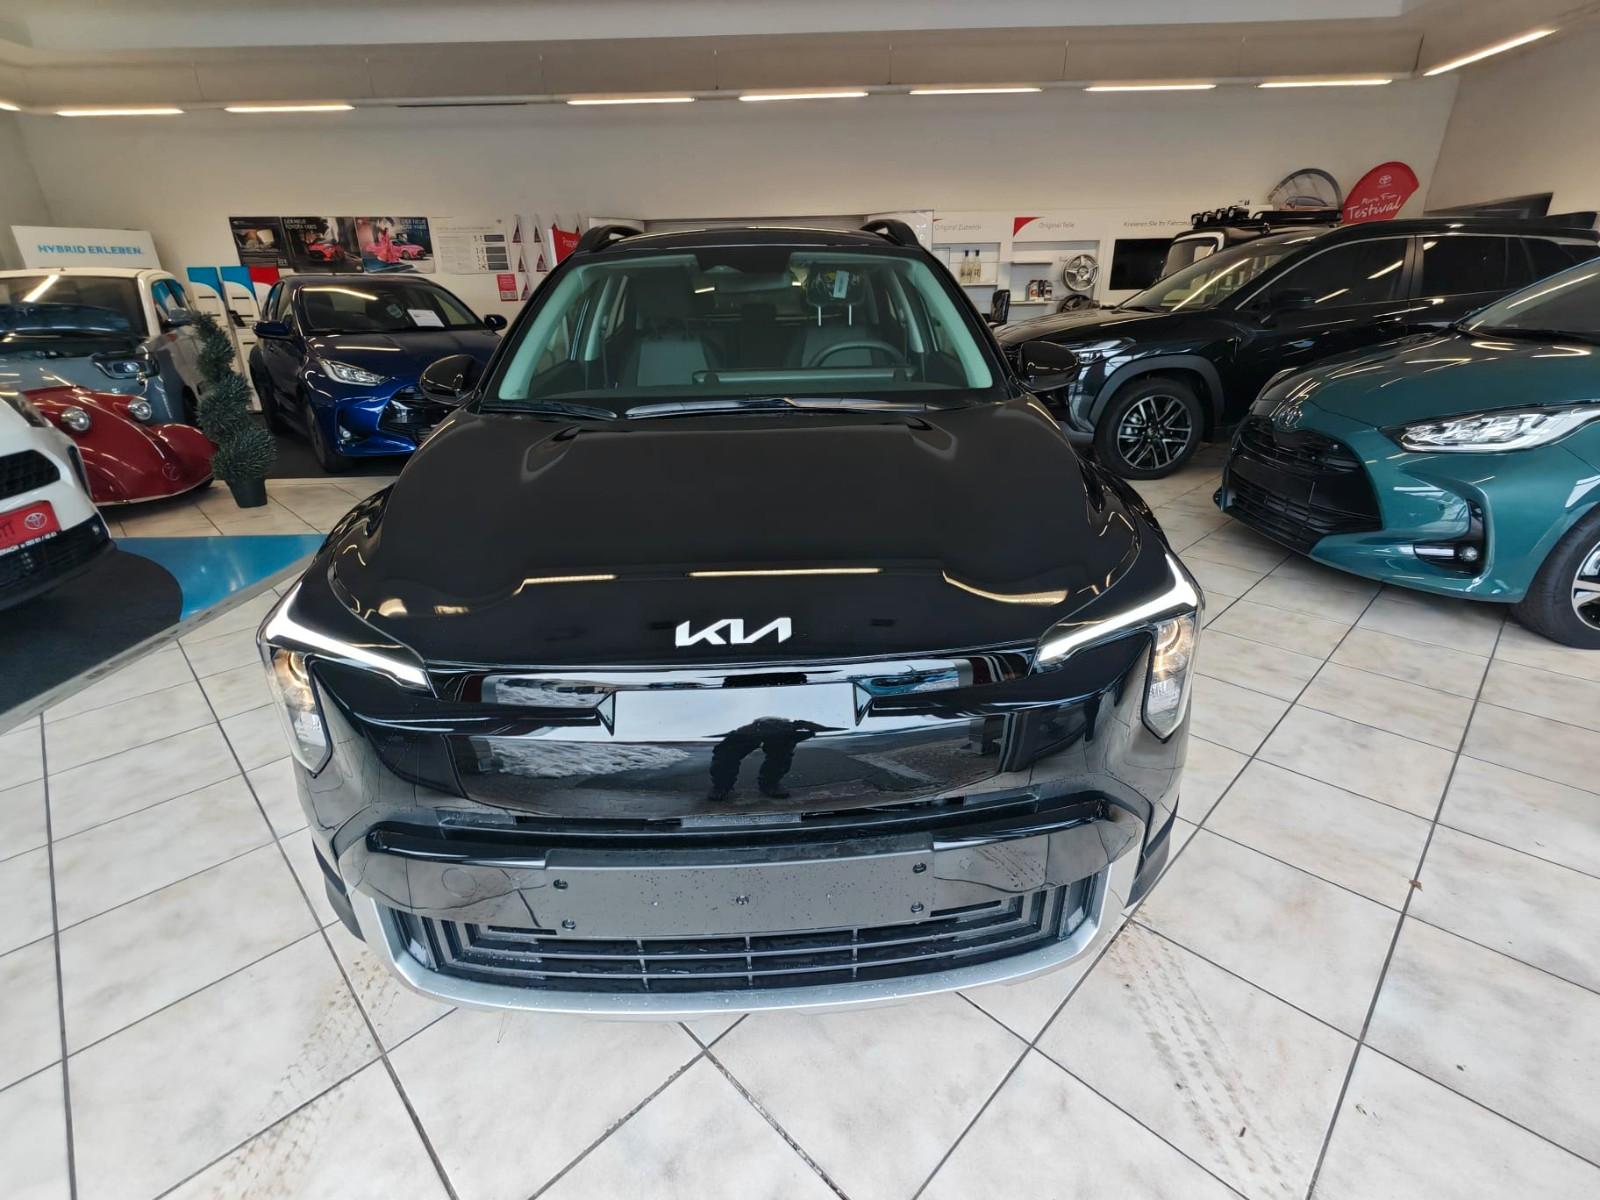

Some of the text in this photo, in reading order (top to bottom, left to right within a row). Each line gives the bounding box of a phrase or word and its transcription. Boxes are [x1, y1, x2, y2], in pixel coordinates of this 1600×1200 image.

[1347, 196, 1401, 220] Testival
[37, 244, 142, 255] HYBRID ERLEBEN
[675, 617, 791, 647] KIA
